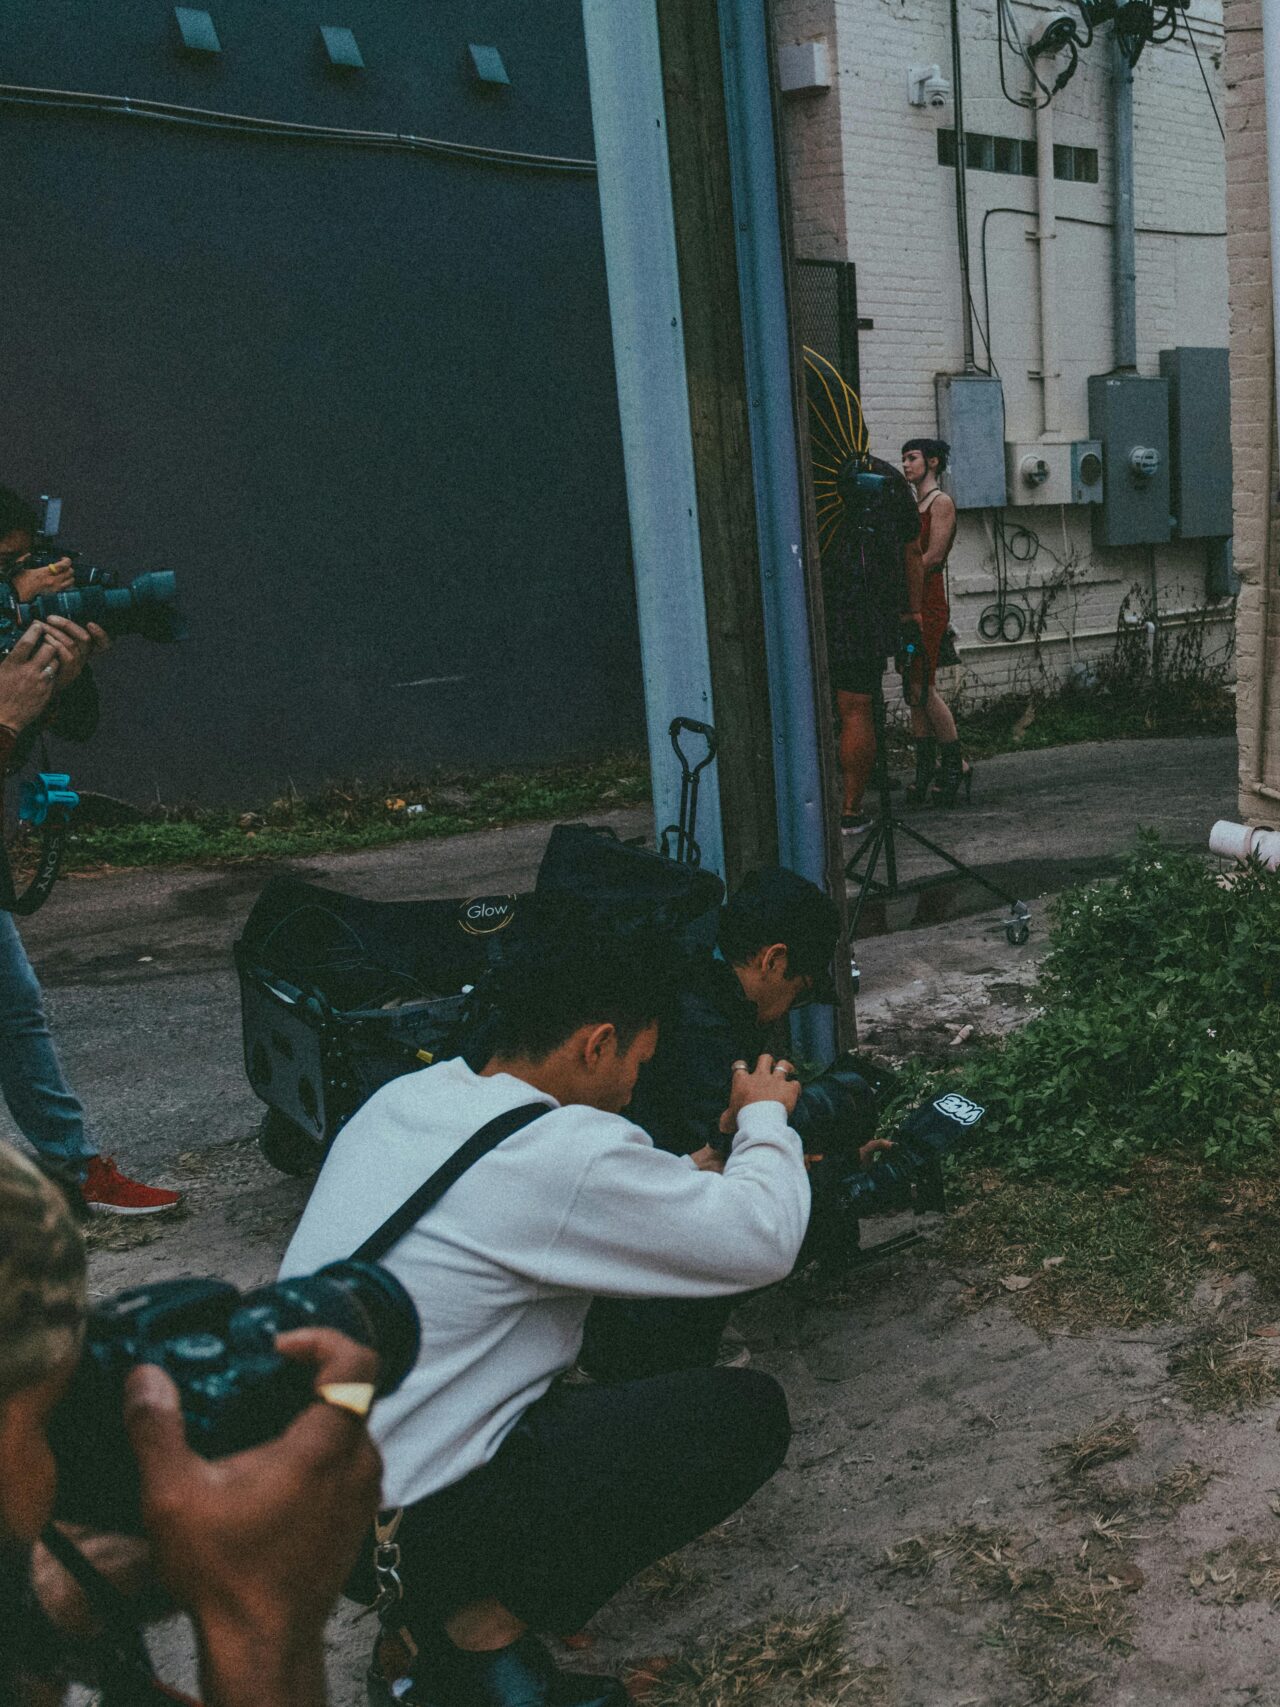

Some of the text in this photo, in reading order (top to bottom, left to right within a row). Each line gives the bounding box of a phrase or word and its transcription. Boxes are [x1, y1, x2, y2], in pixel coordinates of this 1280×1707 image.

[36, 837, 60, 891] SONY
[467, 903, 508, 919] Glow
[936, 1095, 983, 1123] VICE
